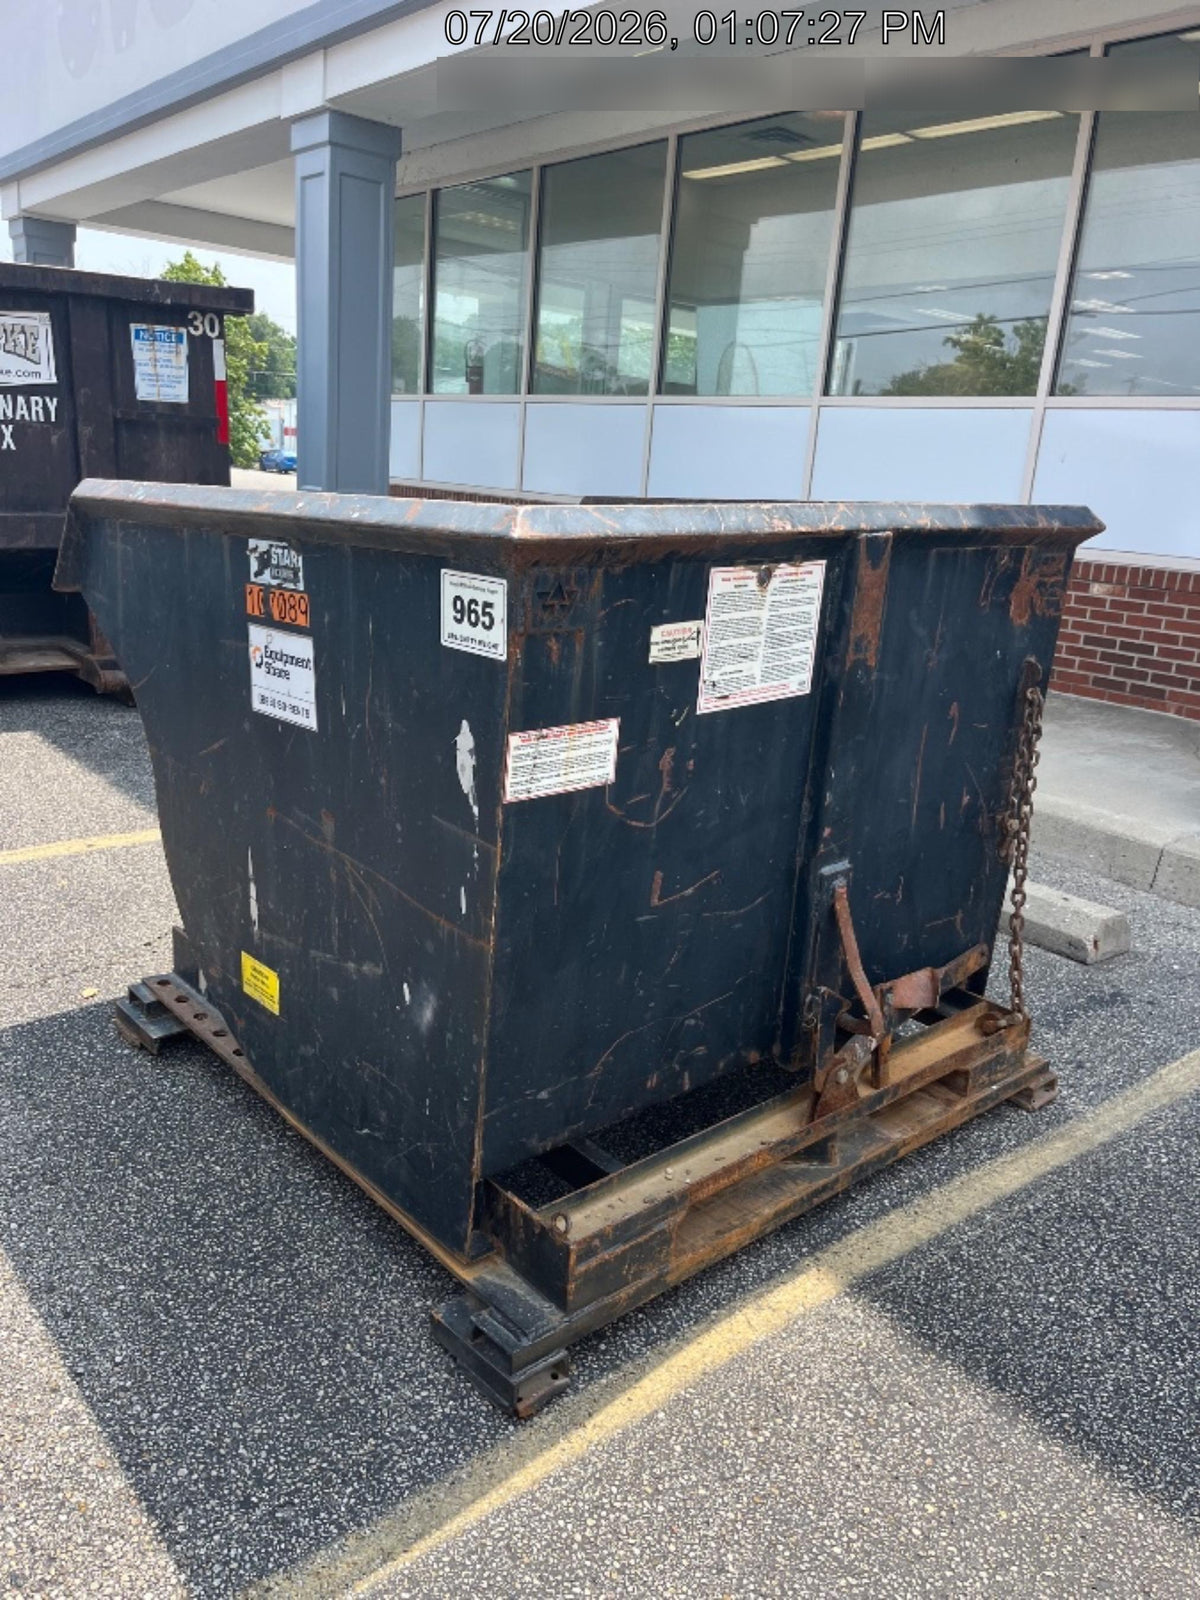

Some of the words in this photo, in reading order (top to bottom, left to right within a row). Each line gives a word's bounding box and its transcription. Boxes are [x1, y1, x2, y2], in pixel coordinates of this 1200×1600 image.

[188, 311, 220, 338] 30
[0, 322, 41, 365] KE
[1, 424, 17, 451] X
[452, 595, 495, 631] 965
[264, 644, 312, 671] Equipment
[264, 661, 291, 681] Share
